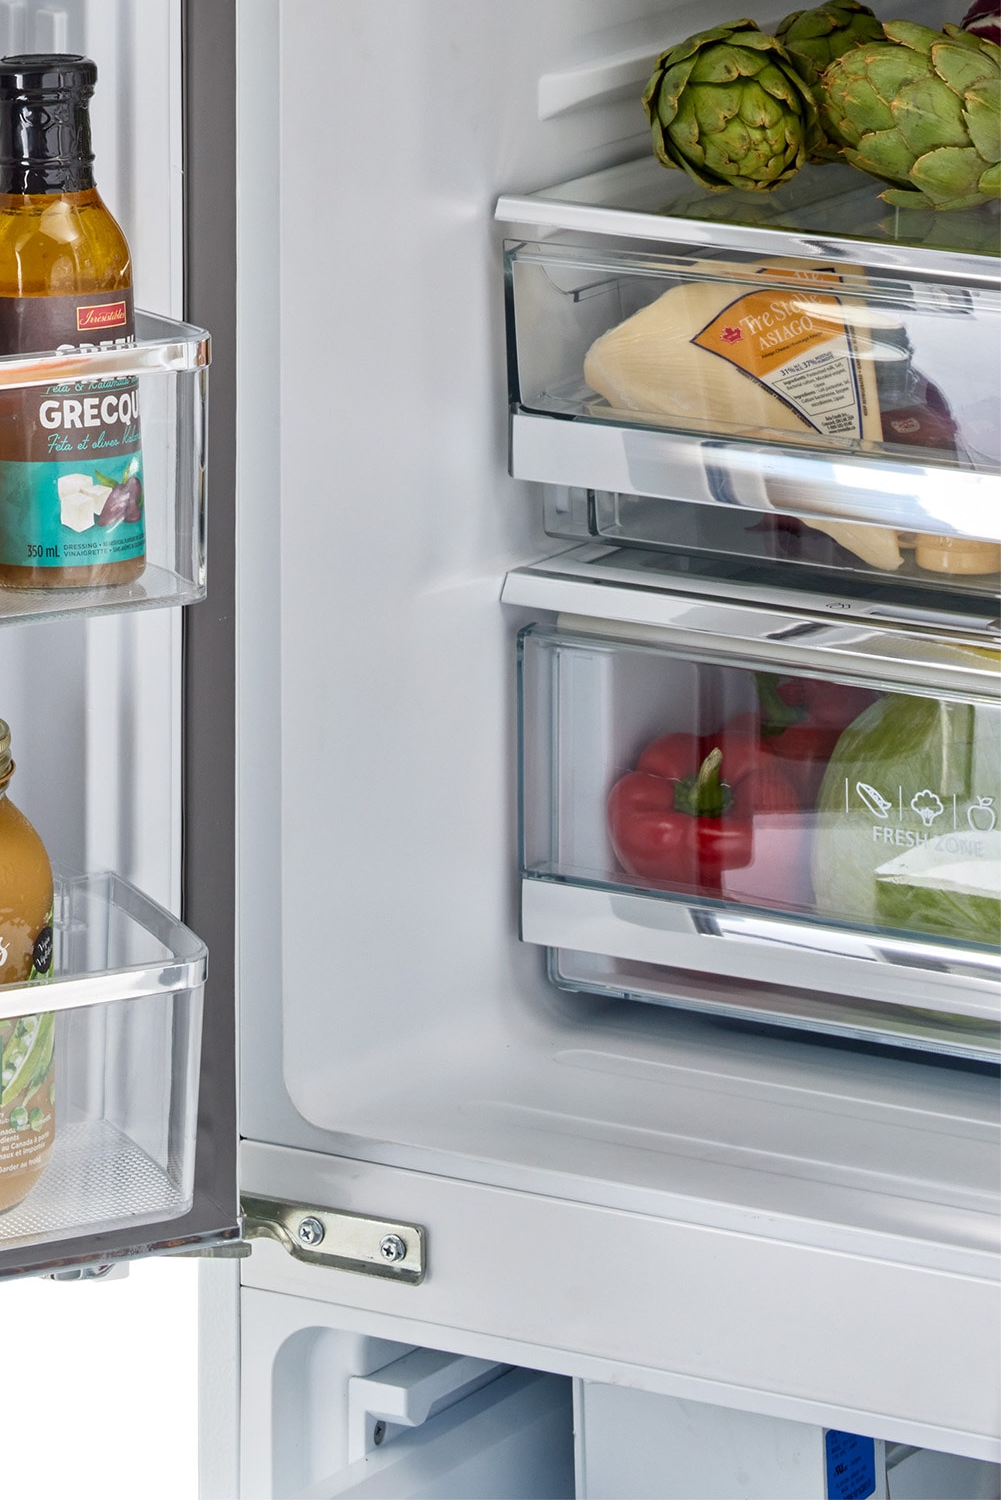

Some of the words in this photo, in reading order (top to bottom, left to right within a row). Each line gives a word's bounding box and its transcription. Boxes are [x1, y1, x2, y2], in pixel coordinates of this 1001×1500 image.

[739, 310, 775, 336] Tre
[758, 315, 814, 351] ASIAGO
[39, 389, 139, 429] GRECQU
[48, 433, 73, 453] Feta
[27, 544, 42, 557] 350
[46, 545, 60, 558] mL
[64, 549, 108, 557] VINAIGRETTE
[873, 825, 928, 848] FRESH
[935, 835, 984, 857] ZONE
[11, 1139, 33, 1150] Canada
